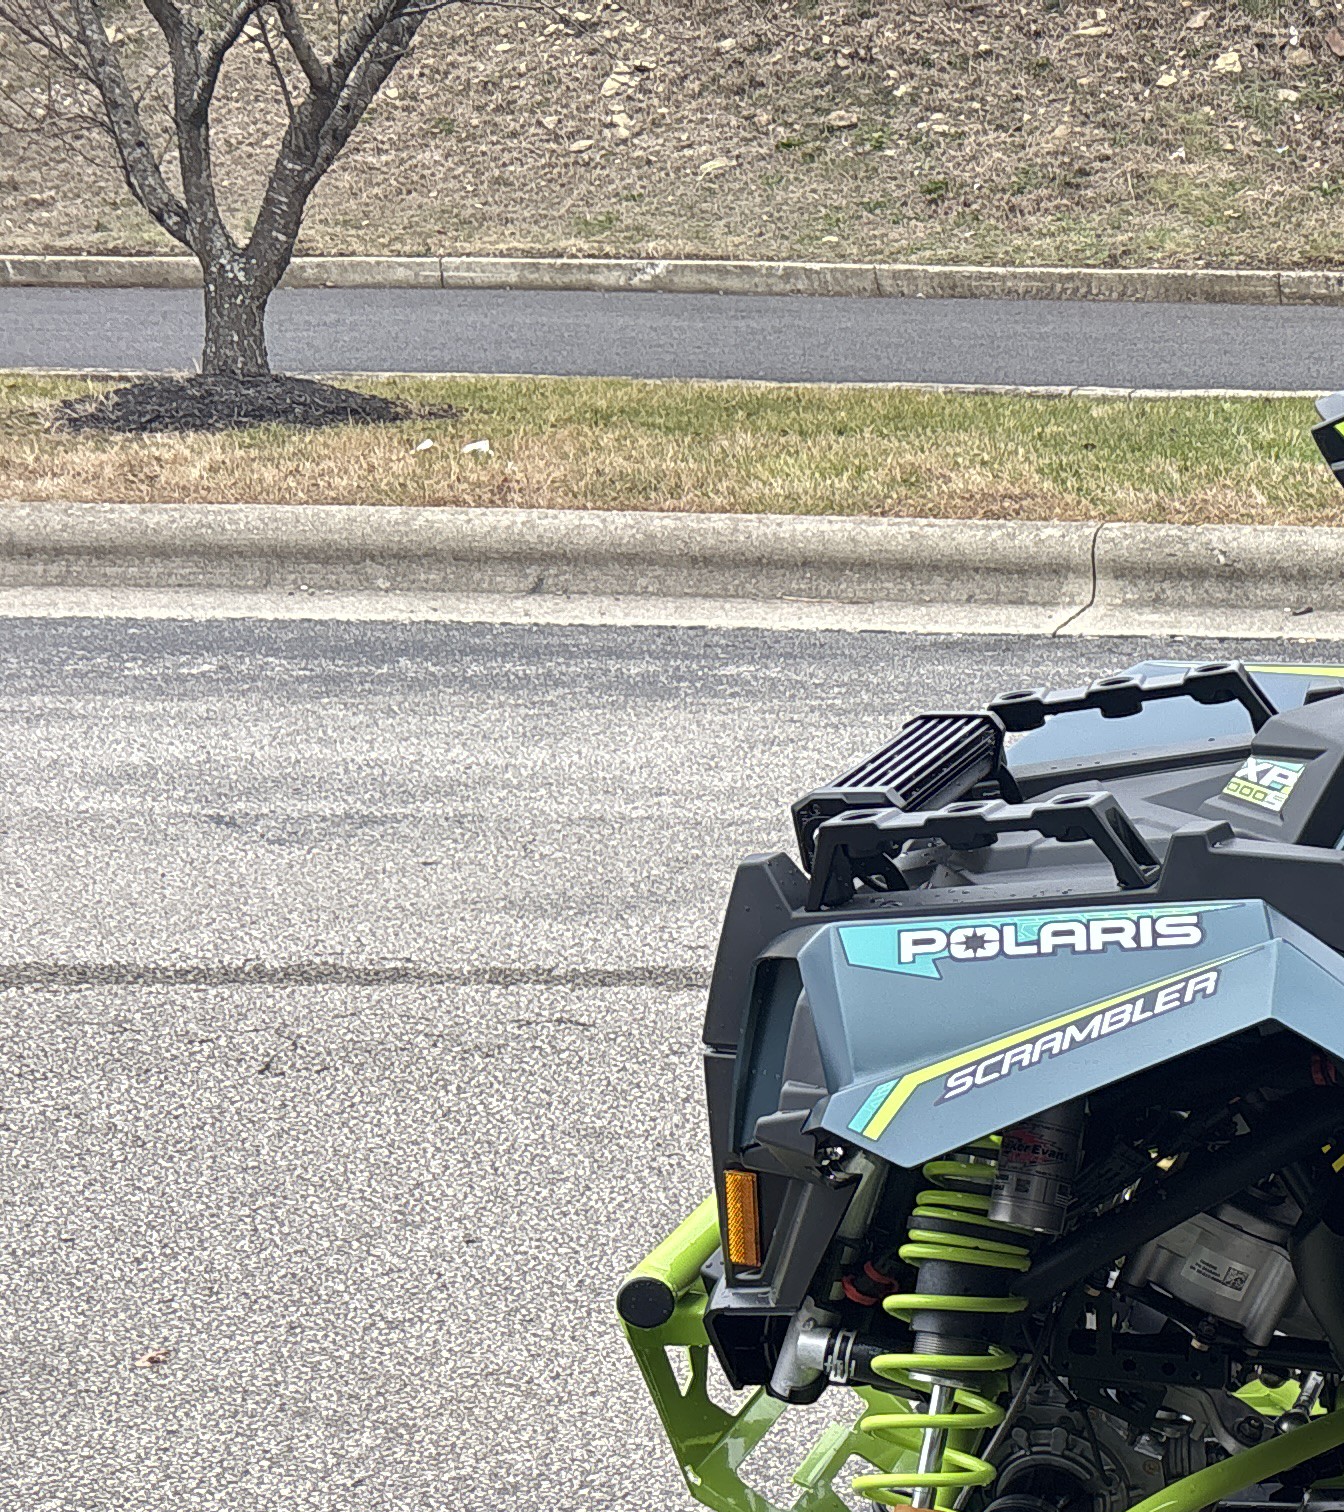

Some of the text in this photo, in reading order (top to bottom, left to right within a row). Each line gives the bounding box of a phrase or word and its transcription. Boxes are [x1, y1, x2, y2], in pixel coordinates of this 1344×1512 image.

[1235, 757, 1304, 788] XP
[899, 914, 1203, 964] POLARIS
[945, 969, 1219, 1100] SCRAMBLER
